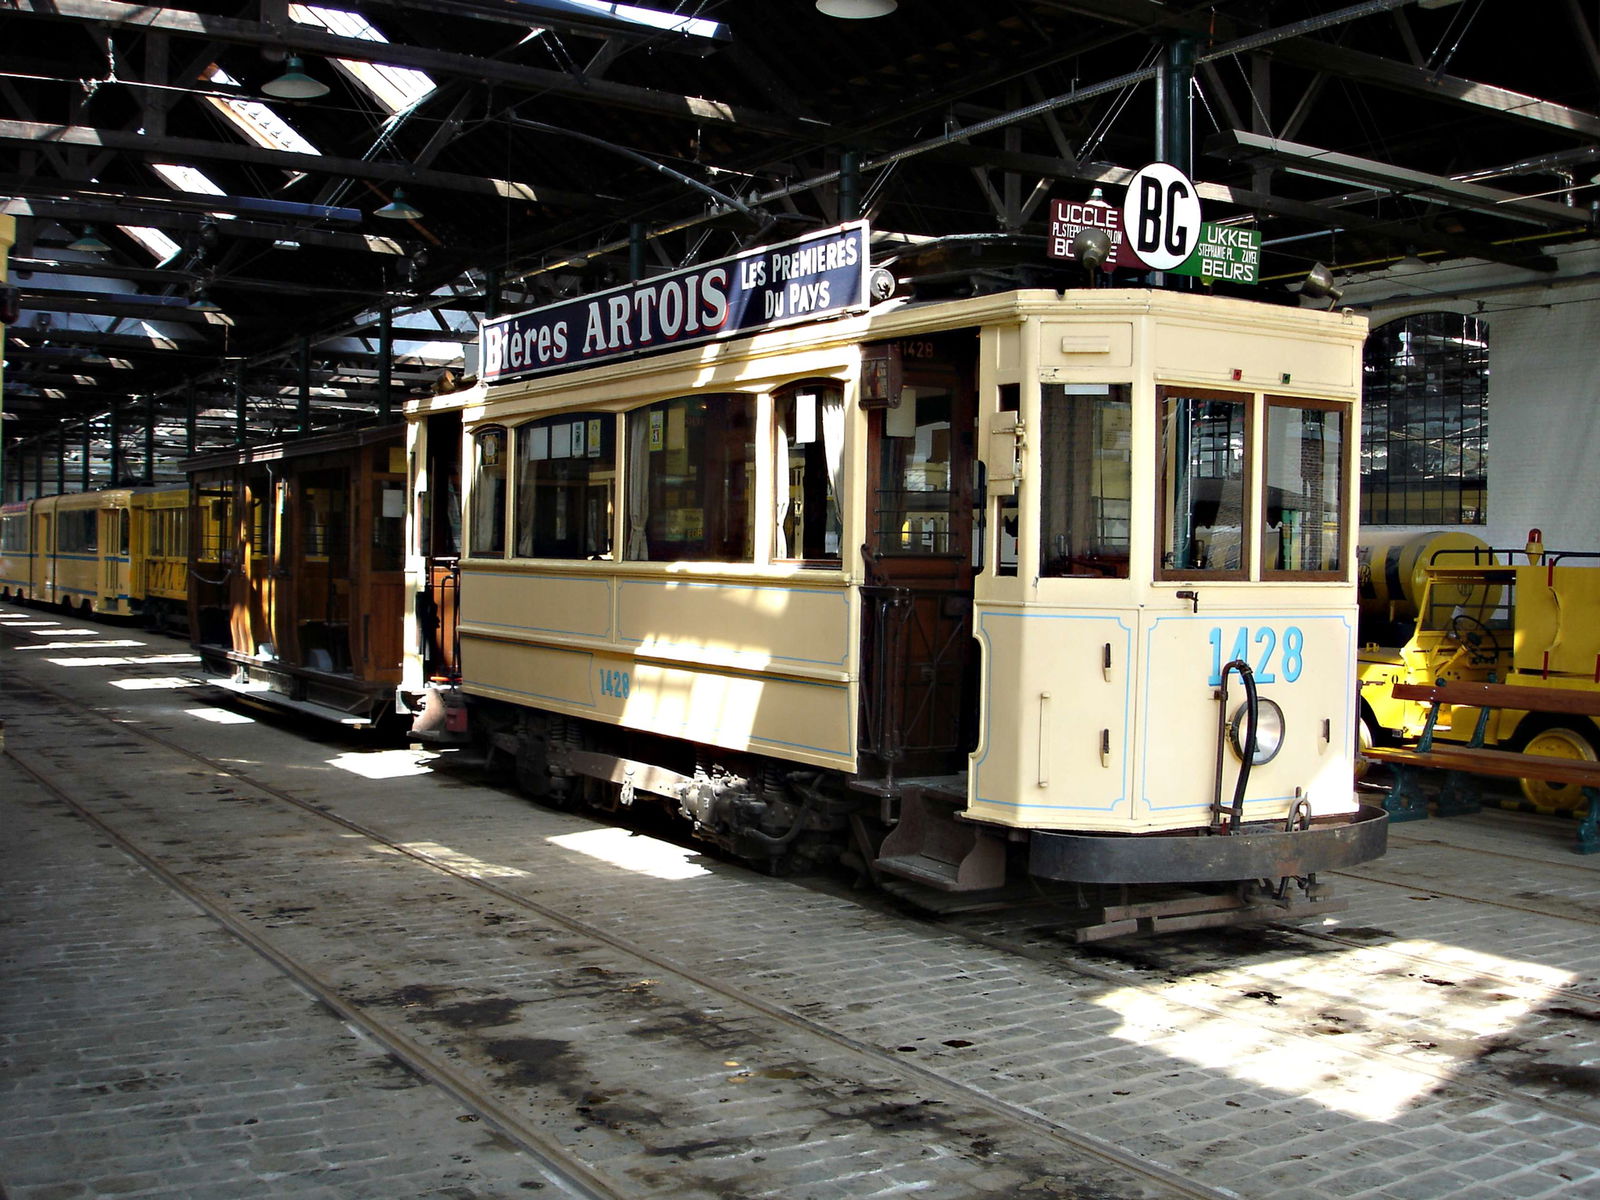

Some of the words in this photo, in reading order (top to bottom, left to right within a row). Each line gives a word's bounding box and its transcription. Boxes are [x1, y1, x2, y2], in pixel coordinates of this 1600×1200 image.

[1058, 203, 1118, 229] UCCLE
[1137, 175, 1189, 257] BG
[1054, 238, 1118, 263] BOE
[1207, 225, 1259, 250] UKKEL
[740, 261, 767, 290] LES
[772, 237, 858, 284] PREMIERES
[1201, 258, 1254, 281] BEURS
[764, 290, 785, 319] DU
[789, 281, 831, 314] PAYS
[485, 321, 568, 376] Bières
[582, 268, 729, 353] ARTOIS
[1207, 626, 1304, 686] 1428
[599, 668, 630, 699] 1428
